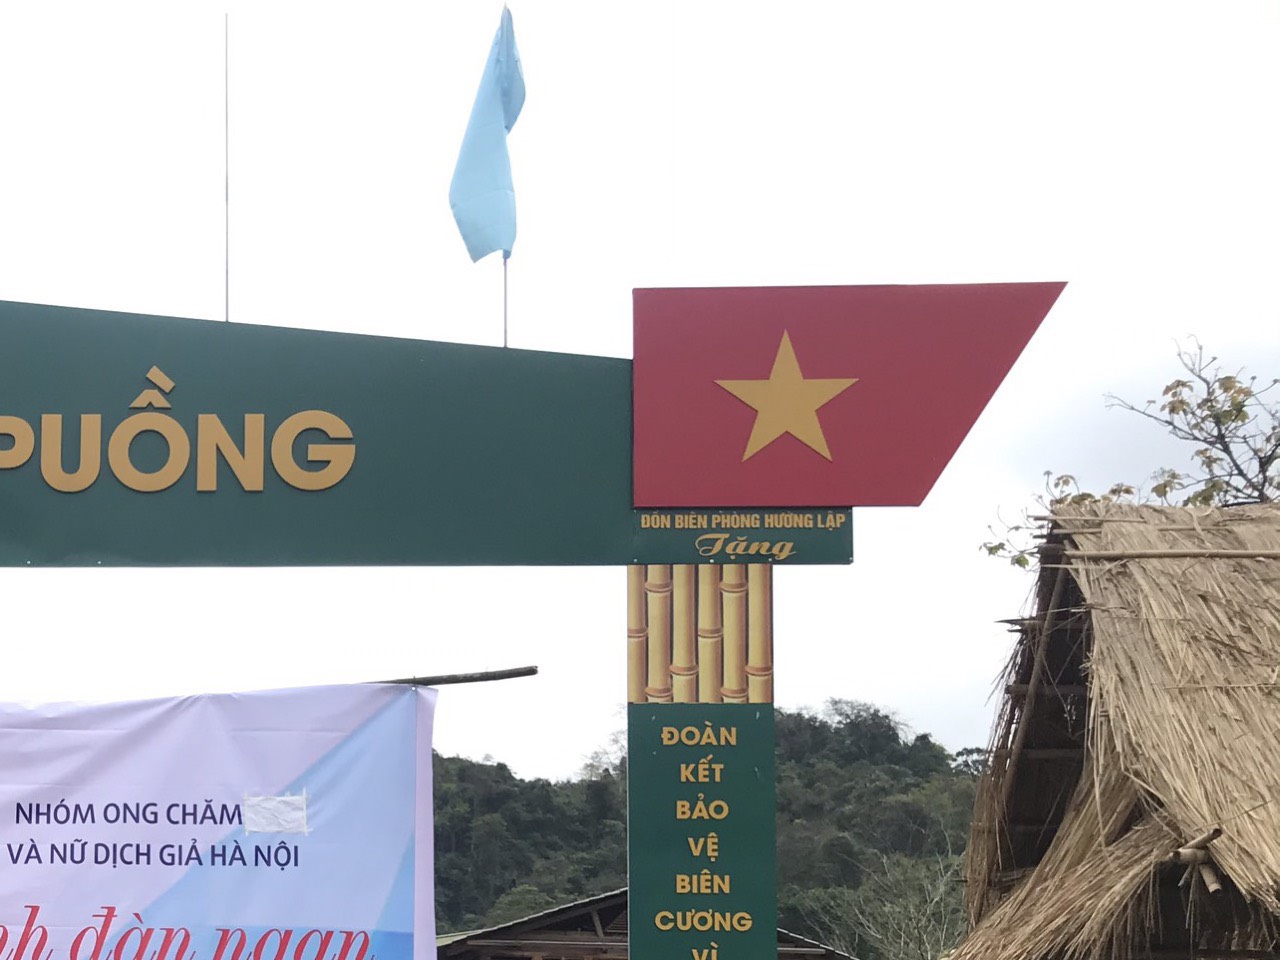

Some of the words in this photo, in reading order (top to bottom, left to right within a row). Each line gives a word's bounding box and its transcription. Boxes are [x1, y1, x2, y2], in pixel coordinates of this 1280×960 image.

[674, 511, 707, 528] BIÊN
[711, 510, 760, 528] PHÒNG
[817, 511, 846, 531] LẬP
[695, 533, 796, 560] Tặng
[661, 720, 737, 746] ĐOÀN
[680, 754, 724, 782] KẾT
[15, 798, 96, 825] NHÓM
[103, 802, 158, 825] ONG
[166, 799, 243, 825] CHĂM
[676, 793, 729, 820] BẢO
[7, 838, 42, 865] VÀ
[50, 838, 88, 865] NỮ
[94, 842, 151, 869] DỊCH
[159, 838, 203, 867] GIẢ
[210, 840, 248, 867] HÀ
[254, 840, 299, 871] NỘI
[687, 832, 719, 862] VỆ
[676, 869, 730, 893] BIÊN
[654, 909, 752, 931] CƯƠNG
